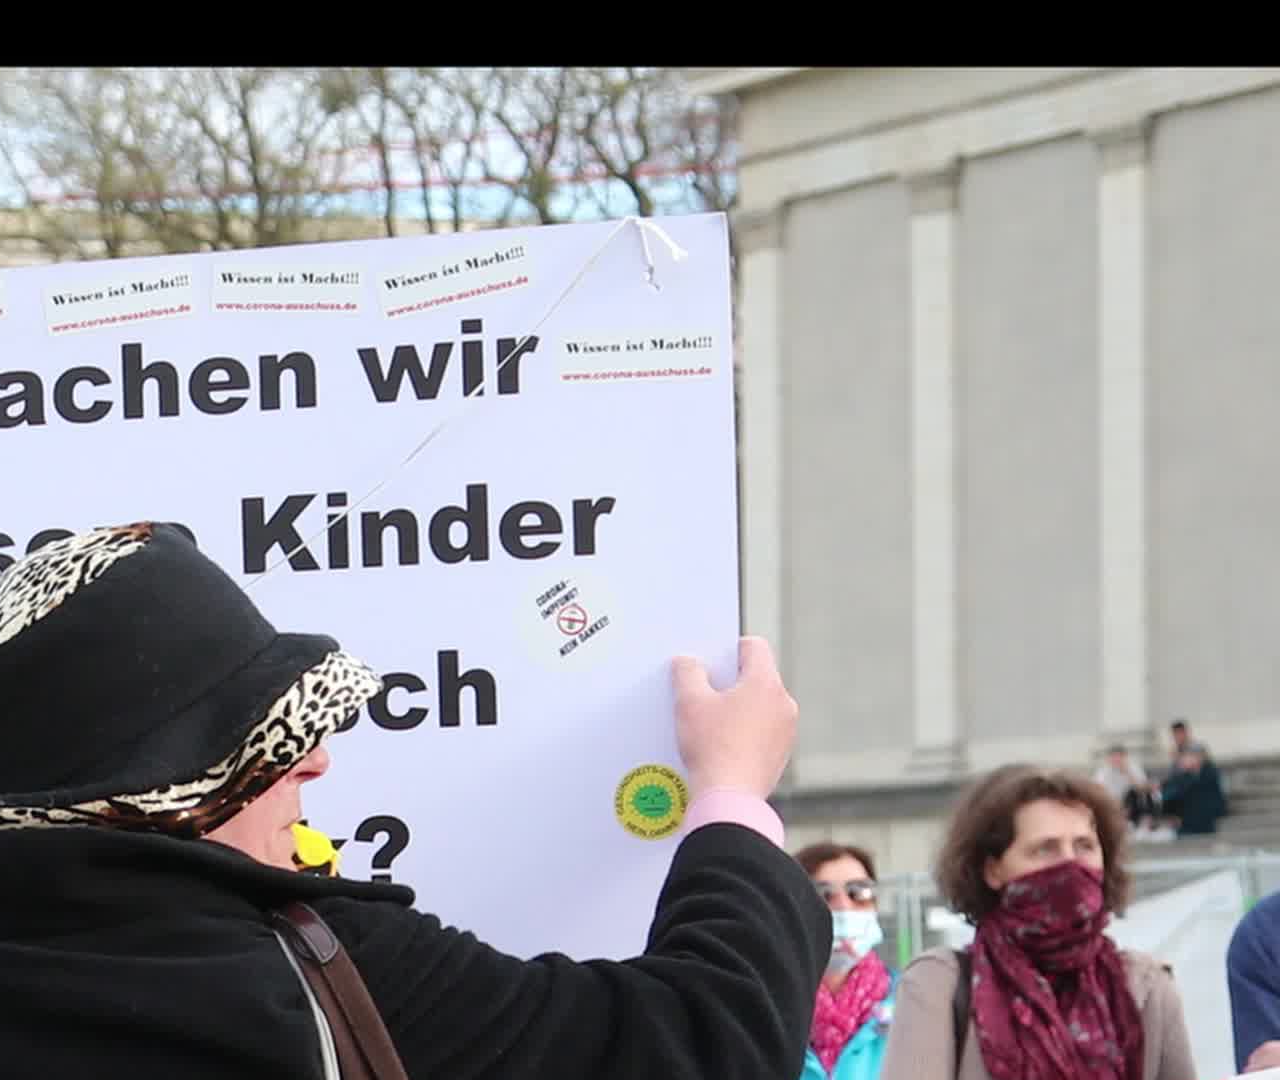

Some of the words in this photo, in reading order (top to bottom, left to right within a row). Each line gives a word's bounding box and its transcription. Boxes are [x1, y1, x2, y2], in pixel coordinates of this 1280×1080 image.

[220, 272, 273, 285] Wissen
[277, 272, 295, 285] ist
[299, 272, 359, 285] Macht!!!
[385, 271, 438, 291] Wissen
[442, 264, 461, 278] ist
[465, 246, 525, 272] Macht!!!
[52, 290, 104, 306] Wissen
[108, 286, 127, 299] ist
[131, 274, 190, 294] Macht!!!
[358, 319, 539, 402] wir
[565, 341, 621, 354] Wissen
[626, 339, 644, 350] ist
[649, 336, 713, 350] Macht!!!
[242, 484, 615, 574] Kinder
